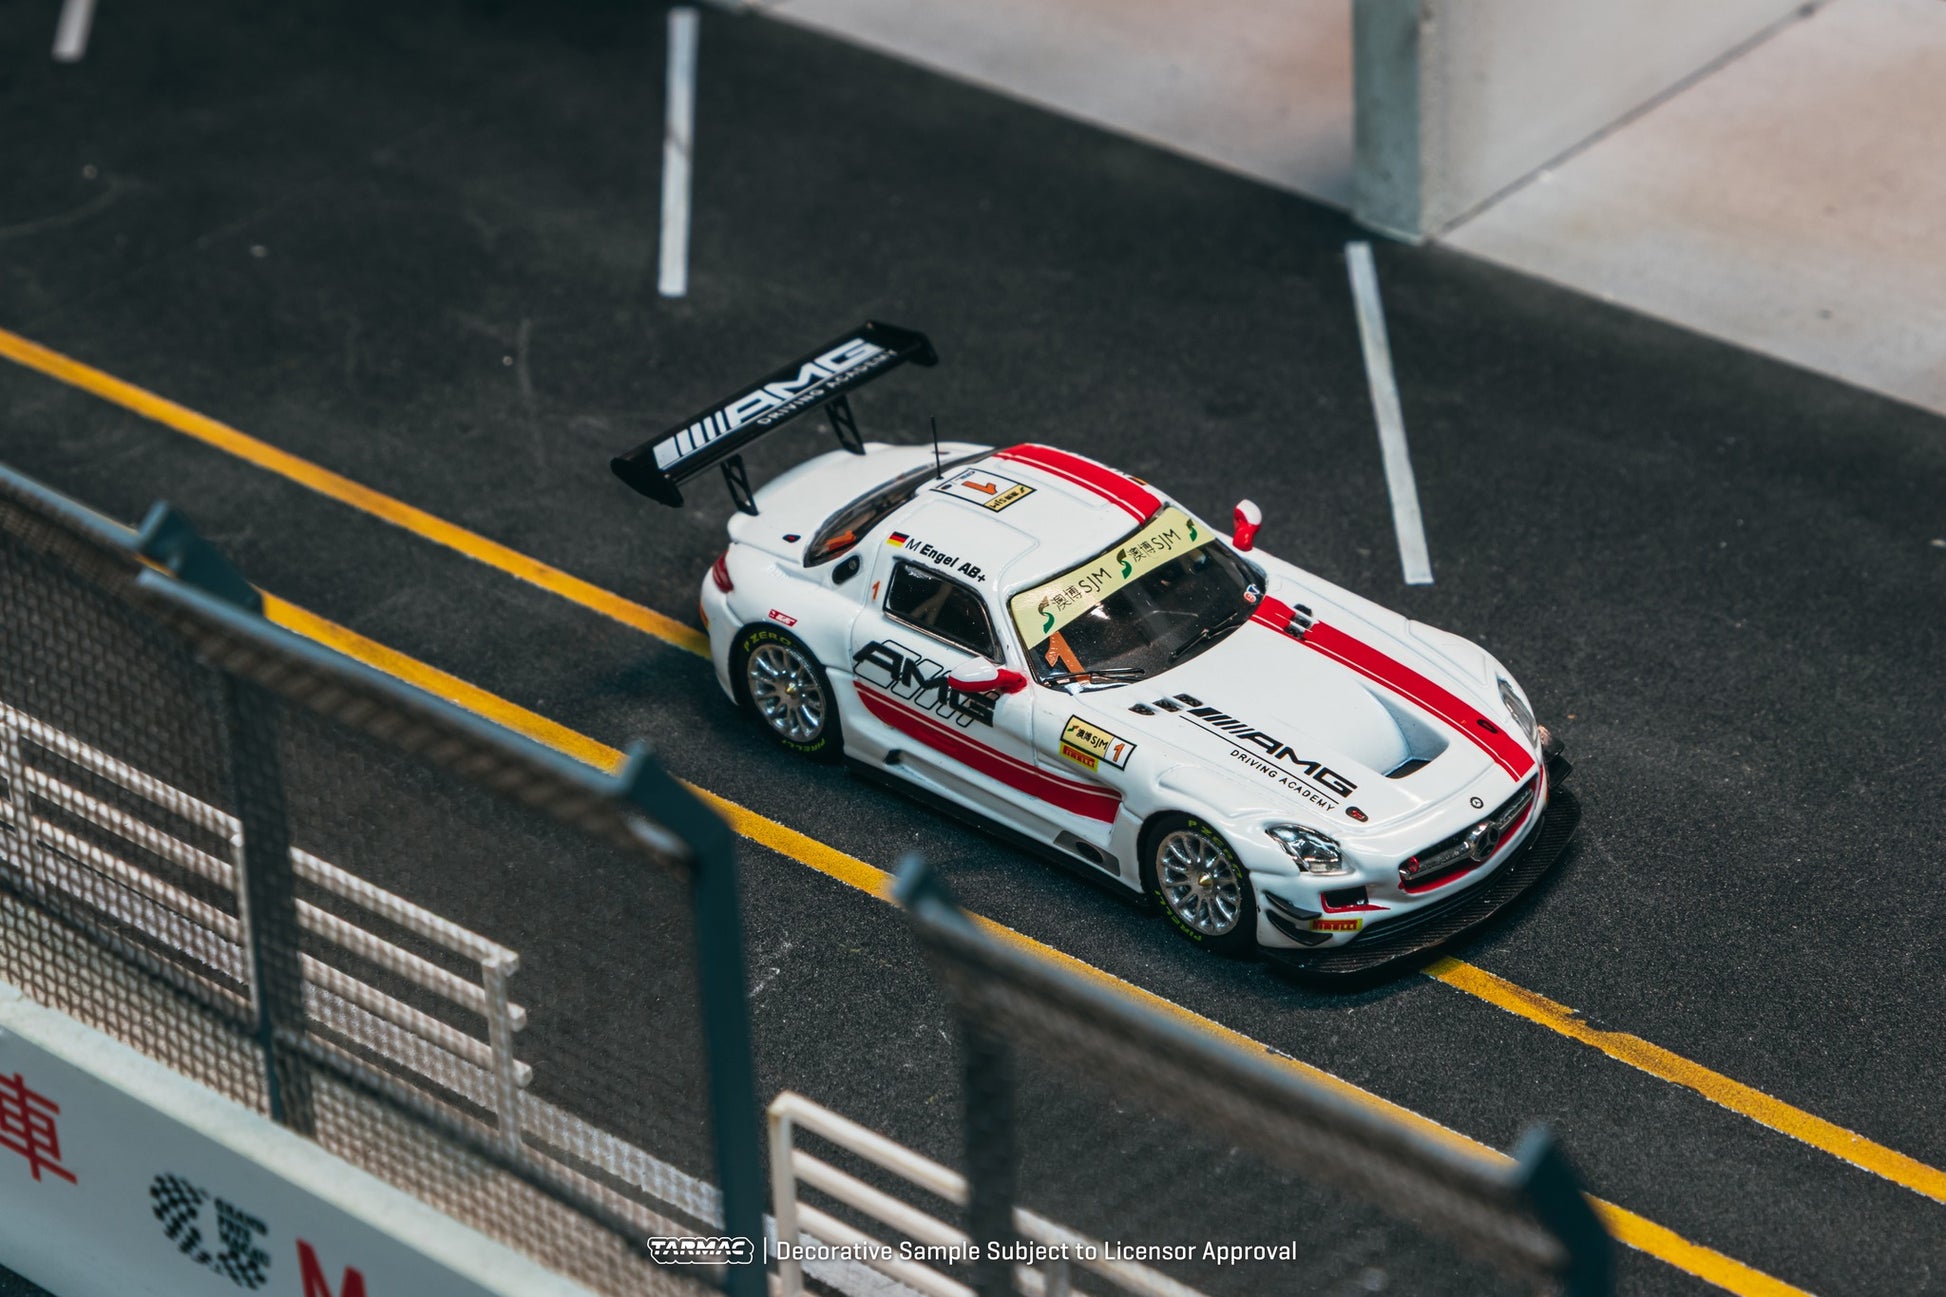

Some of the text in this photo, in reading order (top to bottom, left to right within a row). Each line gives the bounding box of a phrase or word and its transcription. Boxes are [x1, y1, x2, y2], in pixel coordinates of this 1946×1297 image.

[724, 338, 885, 429] AMG
[757, 349, 897, 425] DRIVING ACADEMY
[961, 480, 998, 495] 1
[905, 538, 986, 582] M Engel AB+
[1127, 528, 1182, 562] 澳博 SJM
[872, 580, 880, 601] 1
[1050, 567, 1112, 611] 澳博 SJM
[750, 631, 792, 647] ZERO
[1090, 736, 1108, 751] SJM
[1113, 743, 1125, 762] 1
[1236, 731, 1358, 798] AMG
[1230, 749, 1335, 811] DRIVING ACADEMY
[1201, 826, 1243, 879] ZERO
